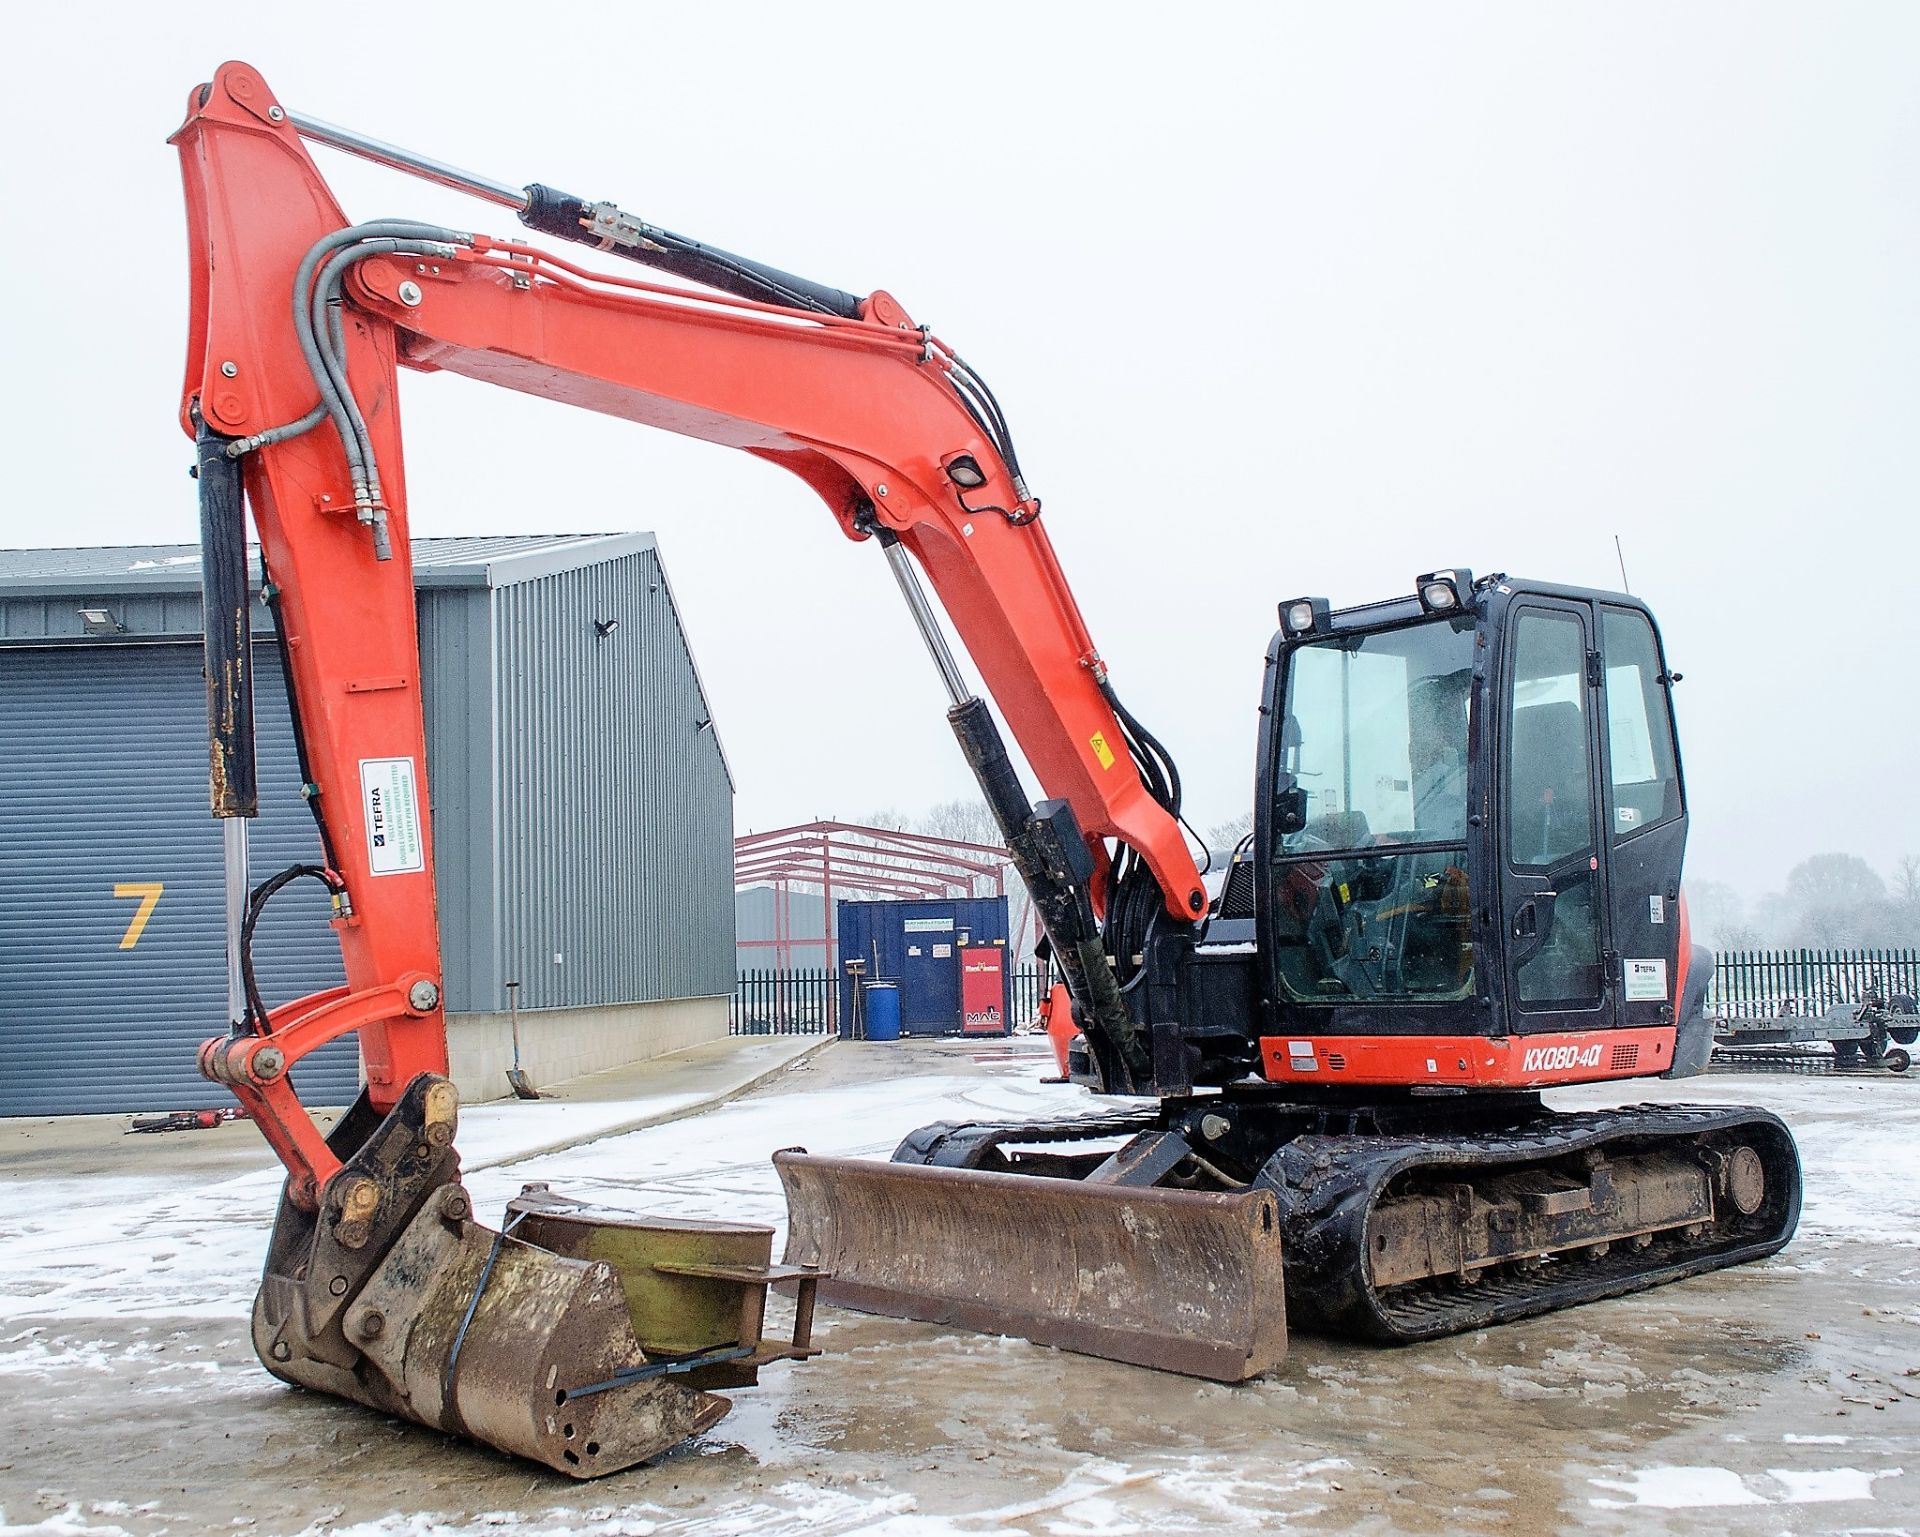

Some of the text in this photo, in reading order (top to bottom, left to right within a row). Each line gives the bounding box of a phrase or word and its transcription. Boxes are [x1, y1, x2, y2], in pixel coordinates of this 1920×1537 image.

[371, 787, 384, 832] TEFRA
[383, 789, 394, 824] AUTOMATIC
[404, 807, 412, 819] PIN
[114, 883, 164, 948] 7
[1640, 965, 1656, 973] TEFRA
